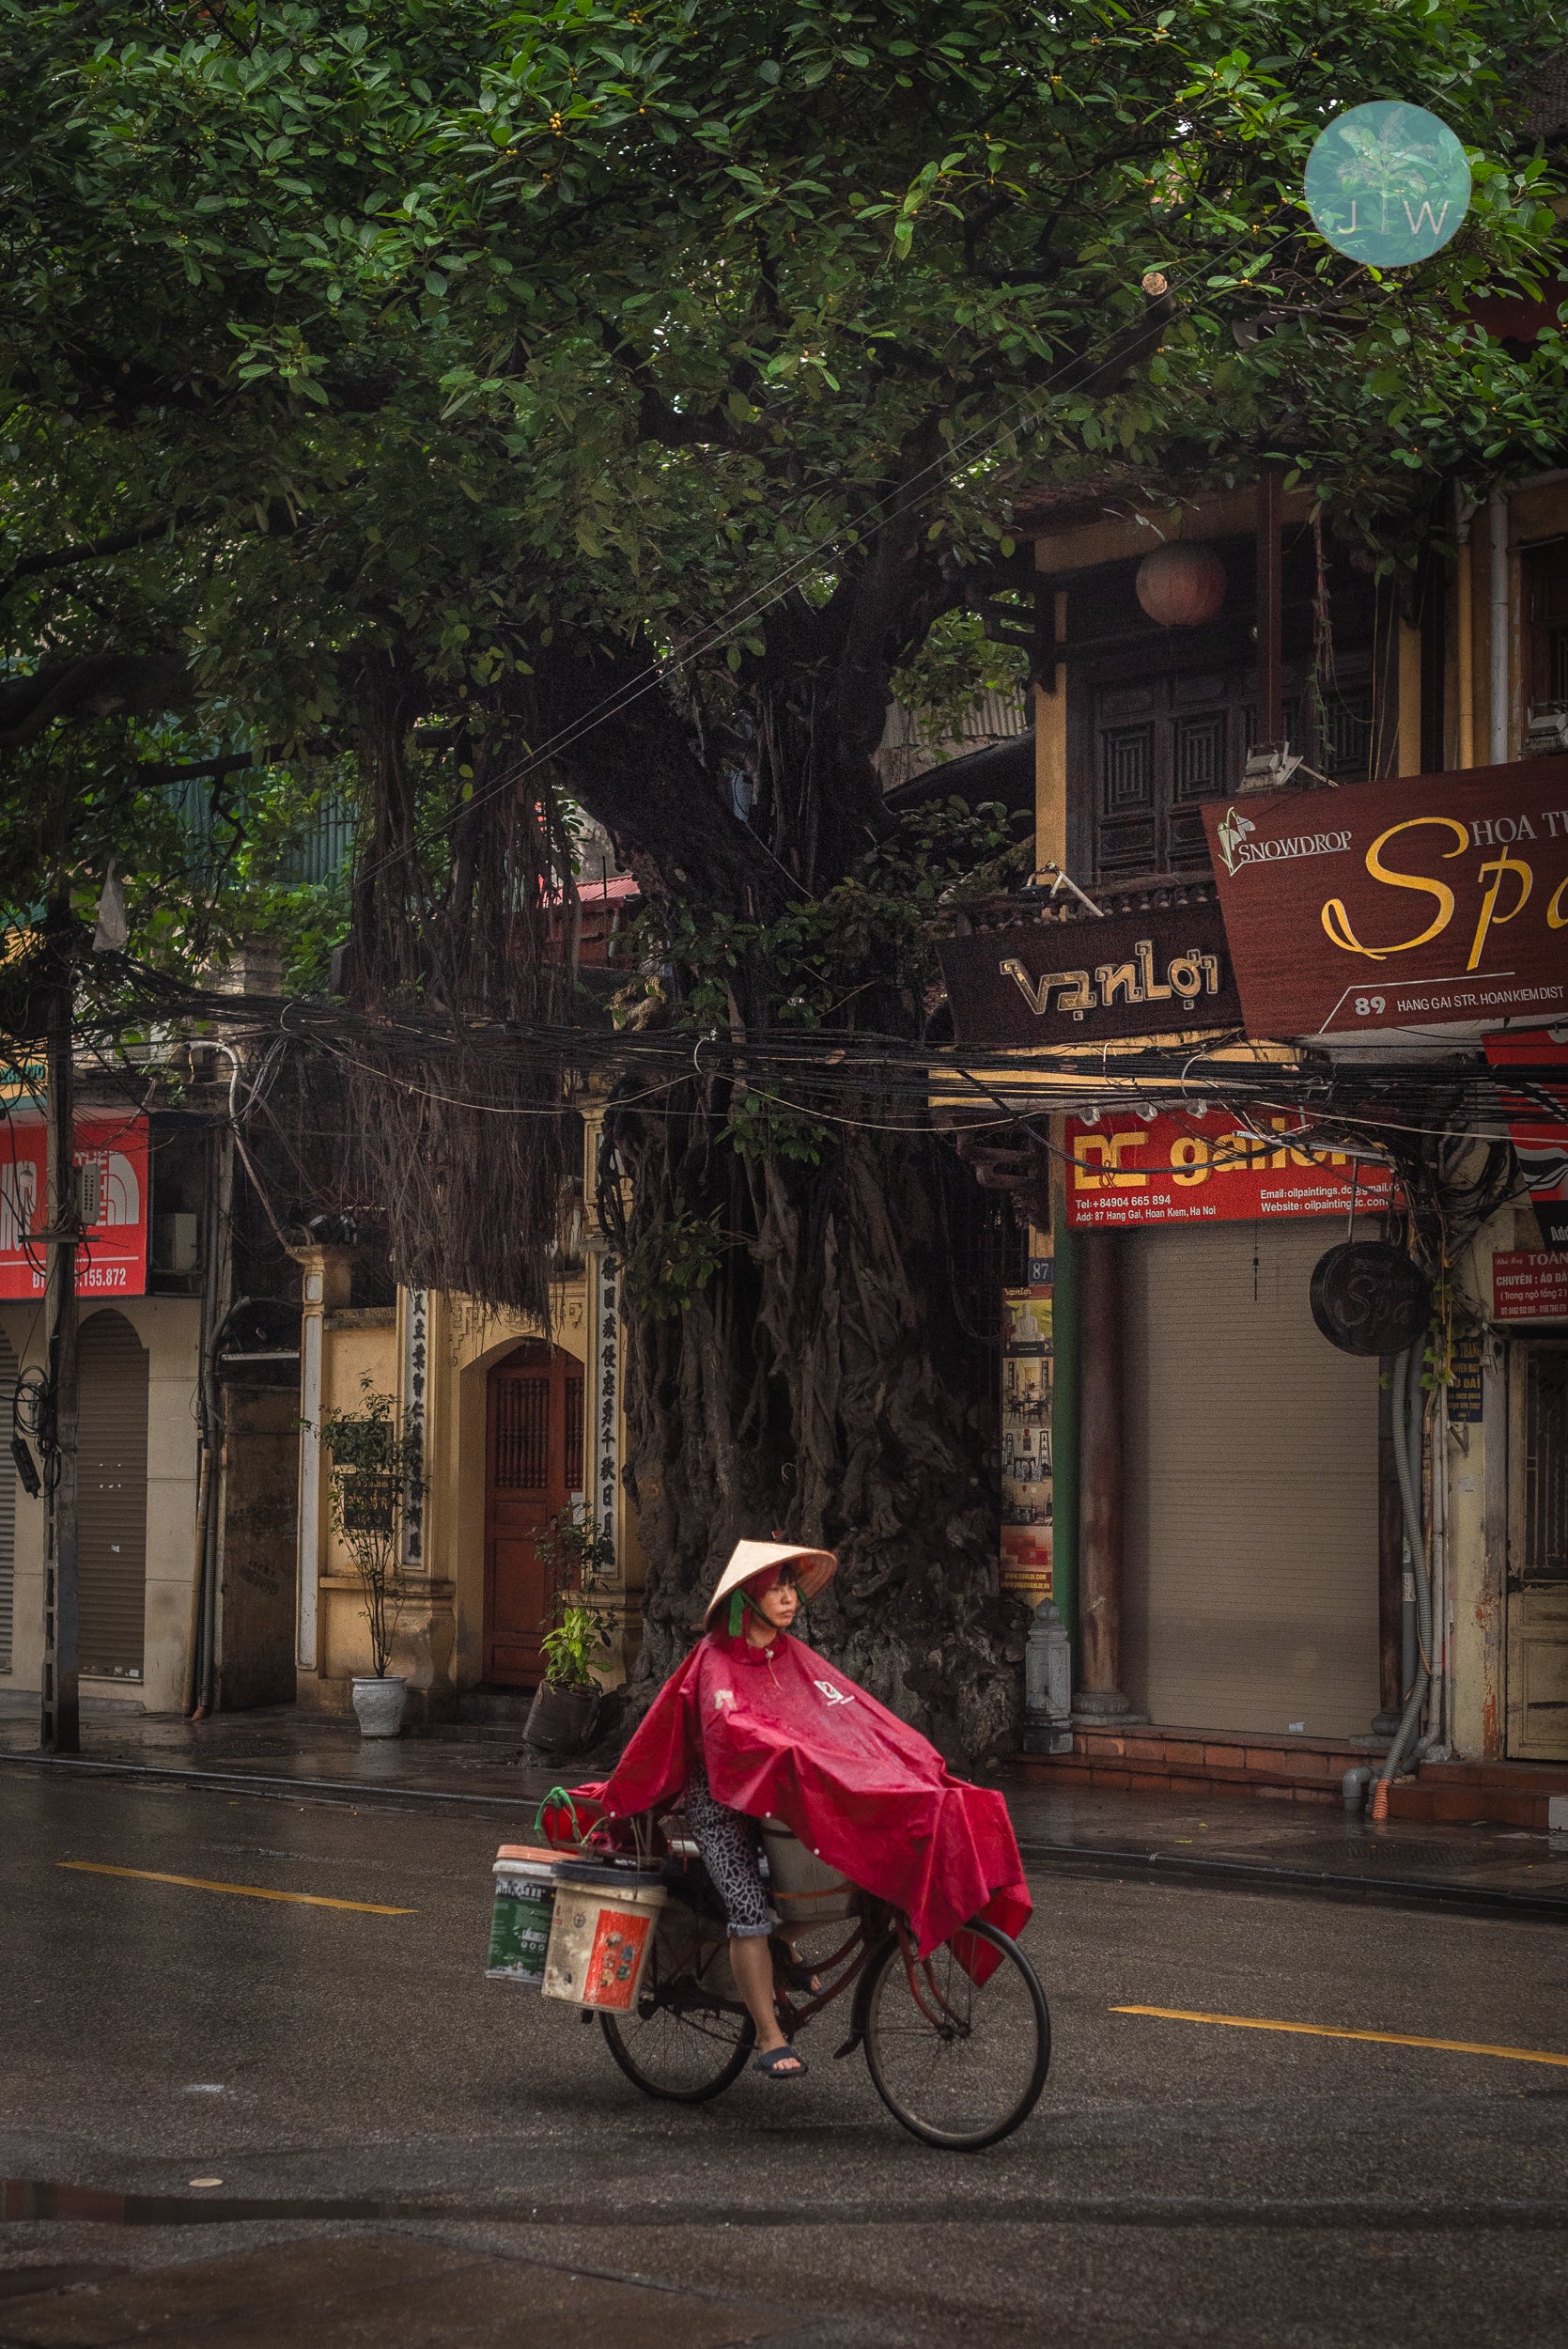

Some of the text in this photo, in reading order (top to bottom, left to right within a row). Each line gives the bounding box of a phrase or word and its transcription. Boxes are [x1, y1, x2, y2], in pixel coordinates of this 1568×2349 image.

[1470, 815, 1537, 846] HOA
[1238, 831, 1352, 863] SNOWDROP
[1355, 997, 1386, 1016] 89
[1397, 998, 1430, 1012] HANG
[1431, 996, 1452, 1008] GAI
[1454, 994, 1479, 1007] STR.
[1131, 1196, 1150, 1206] 665
[1152, 1194, 1172, 1206] 894
[1076, 1212, 1093, 1221] Add:
[1094, 1211, 1104, 1221] 87
[1107, 1210, 1126, 1221] Hang
[1128, 1209, 1144, 1220] Gai,
[1145, 1208, 1165, 1219] Hoan
[1190, 1206, 1201, 1216] Ha
[1203, 1206, 1217, 1215] Noi
[74, 1268, 127, 1288] .155.872
[1033, 1263, 1049, 1279] 87
